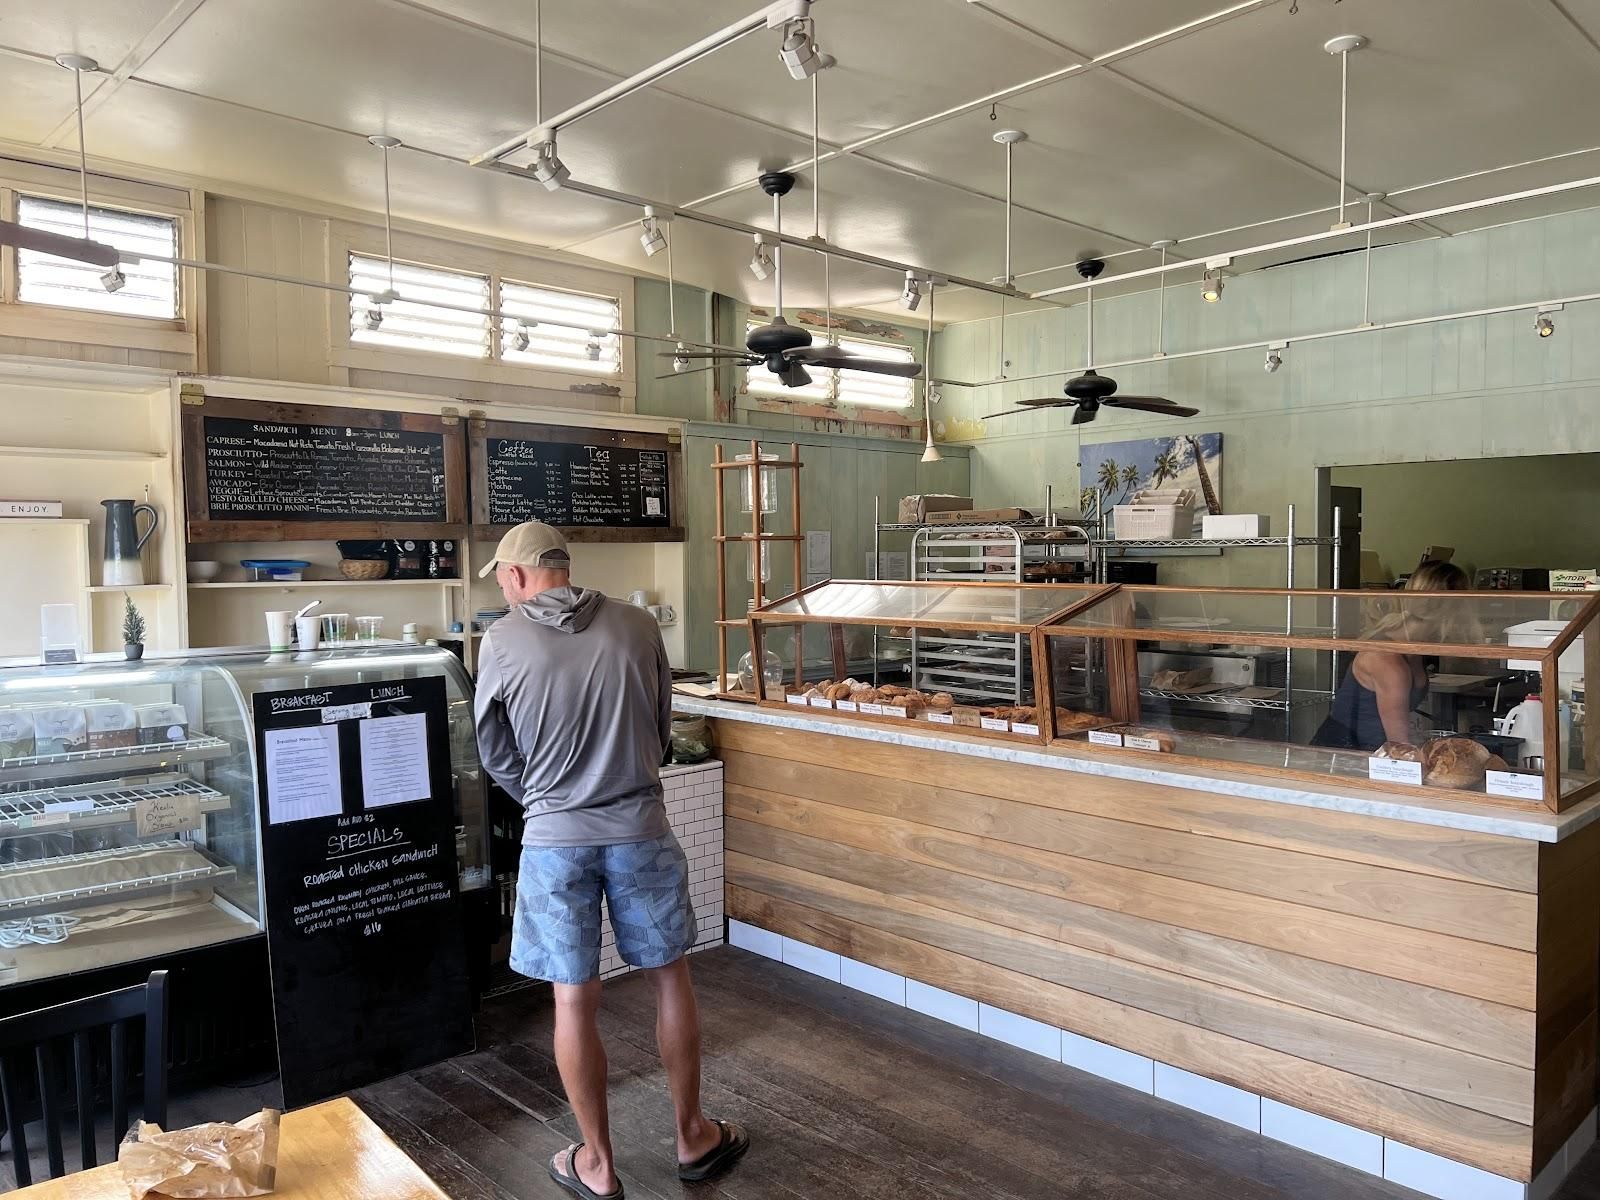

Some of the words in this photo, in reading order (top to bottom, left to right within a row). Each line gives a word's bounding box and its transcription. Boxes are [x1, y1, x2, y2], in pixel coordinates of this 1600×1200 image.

[253, 424, 297, 434] SANDWICH
[310, 427, 337, 435] MENU
[498, 440, 534, 453] Coffee
[584, 446, 610, 459] Tea
[489, 456, 514, 467] Espresso
[490, 467, 508, 475] Latte
[490, 482, 513, 490] Mocha
[491, 490, 524, 498] Americano
[232, 504, 283, 512] PROSCIUTTO
[492, 515, 508, 523] Cold
[509, 515, 524, 523] Brew
[270, 692, 333, 710] BREAKFAST
[370, 685, 405, 700] LUNCH
[338, 818, 350, 827] Add
[328, 828, 404, 854] SPECIALS
[352, 900, 370, 911] LOCAL
[397, 888, 415, 899] LOCAL
[364, 922, 382, 937] $16
